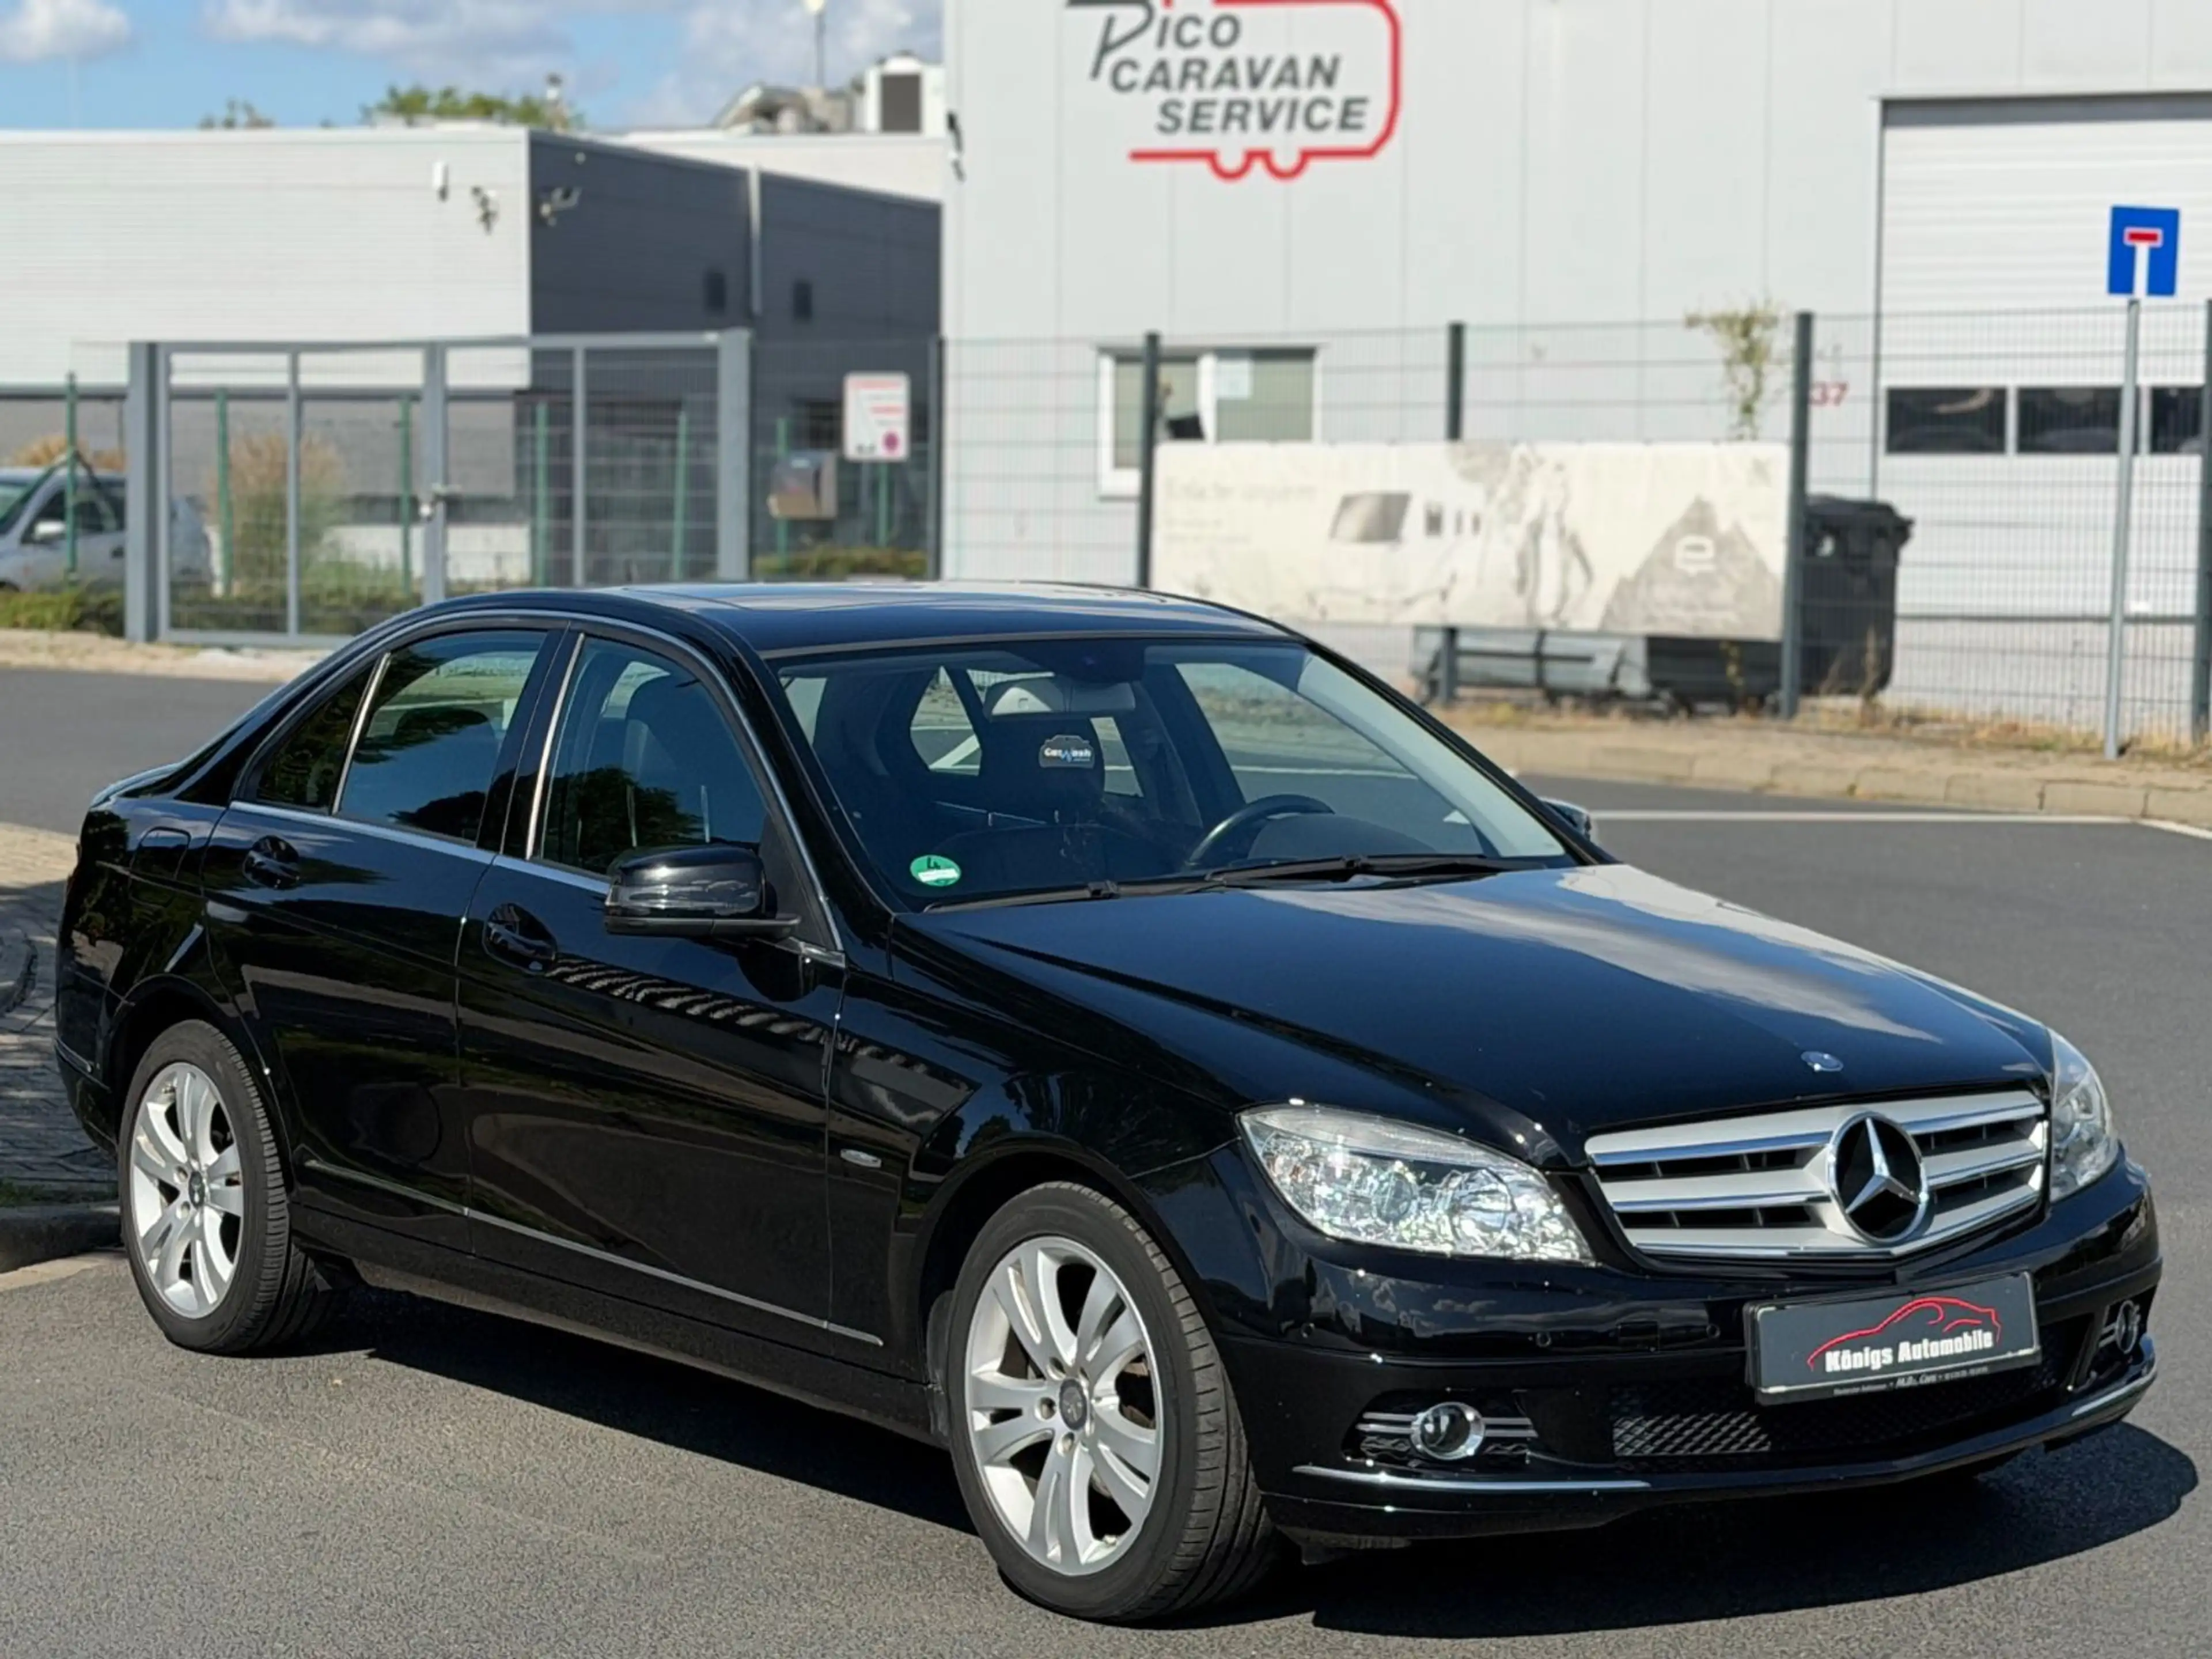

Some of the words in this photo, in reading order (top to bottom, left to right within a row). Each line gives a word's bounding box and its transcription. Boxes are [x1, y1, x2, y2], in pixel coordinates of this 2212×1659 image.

[1110, 54, 1341, 93] CARAVAN
[1154, 96, 1370, 134] SERVICE
[1824, 1346, 1893, 1372] Königs
[1897, 1328, 1994, 1363] Automobile
